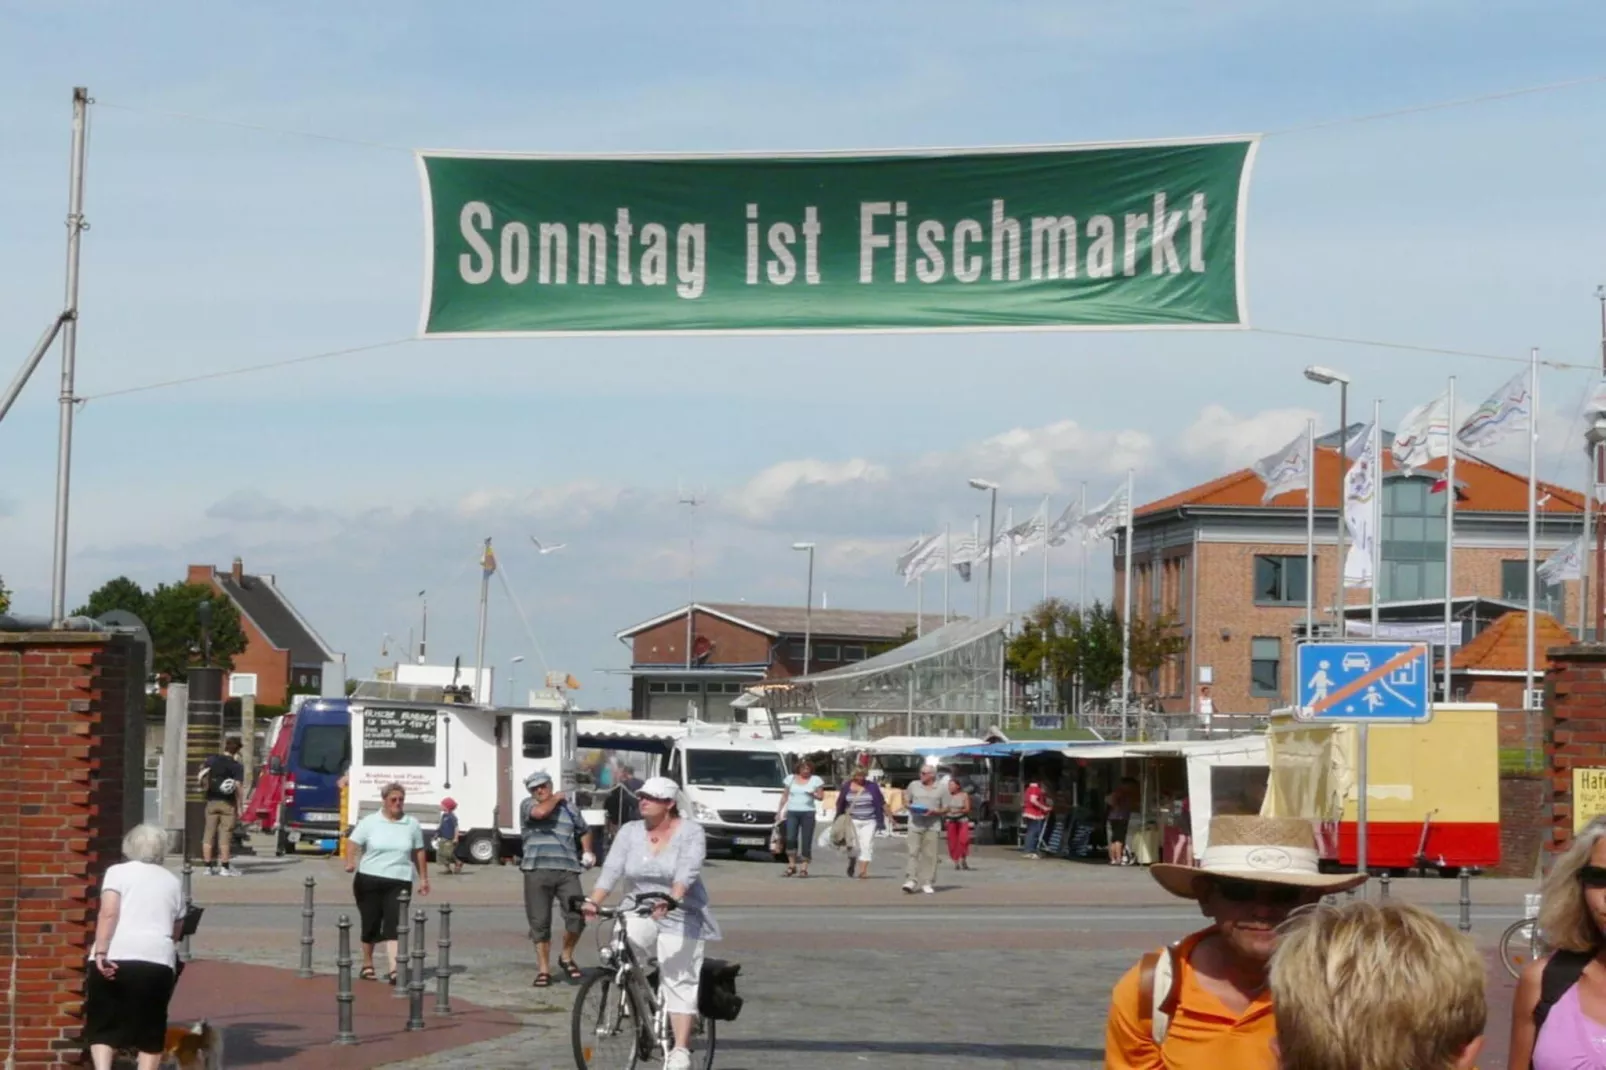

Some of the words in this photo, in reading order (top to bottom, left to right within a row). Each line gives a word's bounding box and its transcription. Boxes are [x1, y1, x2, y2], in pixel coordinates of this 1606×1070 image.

[459, 201, 706, 299] Sonntag
[746, 203, 821, 285] ist
[859, 192, 1207, 283] Fischmarkt
